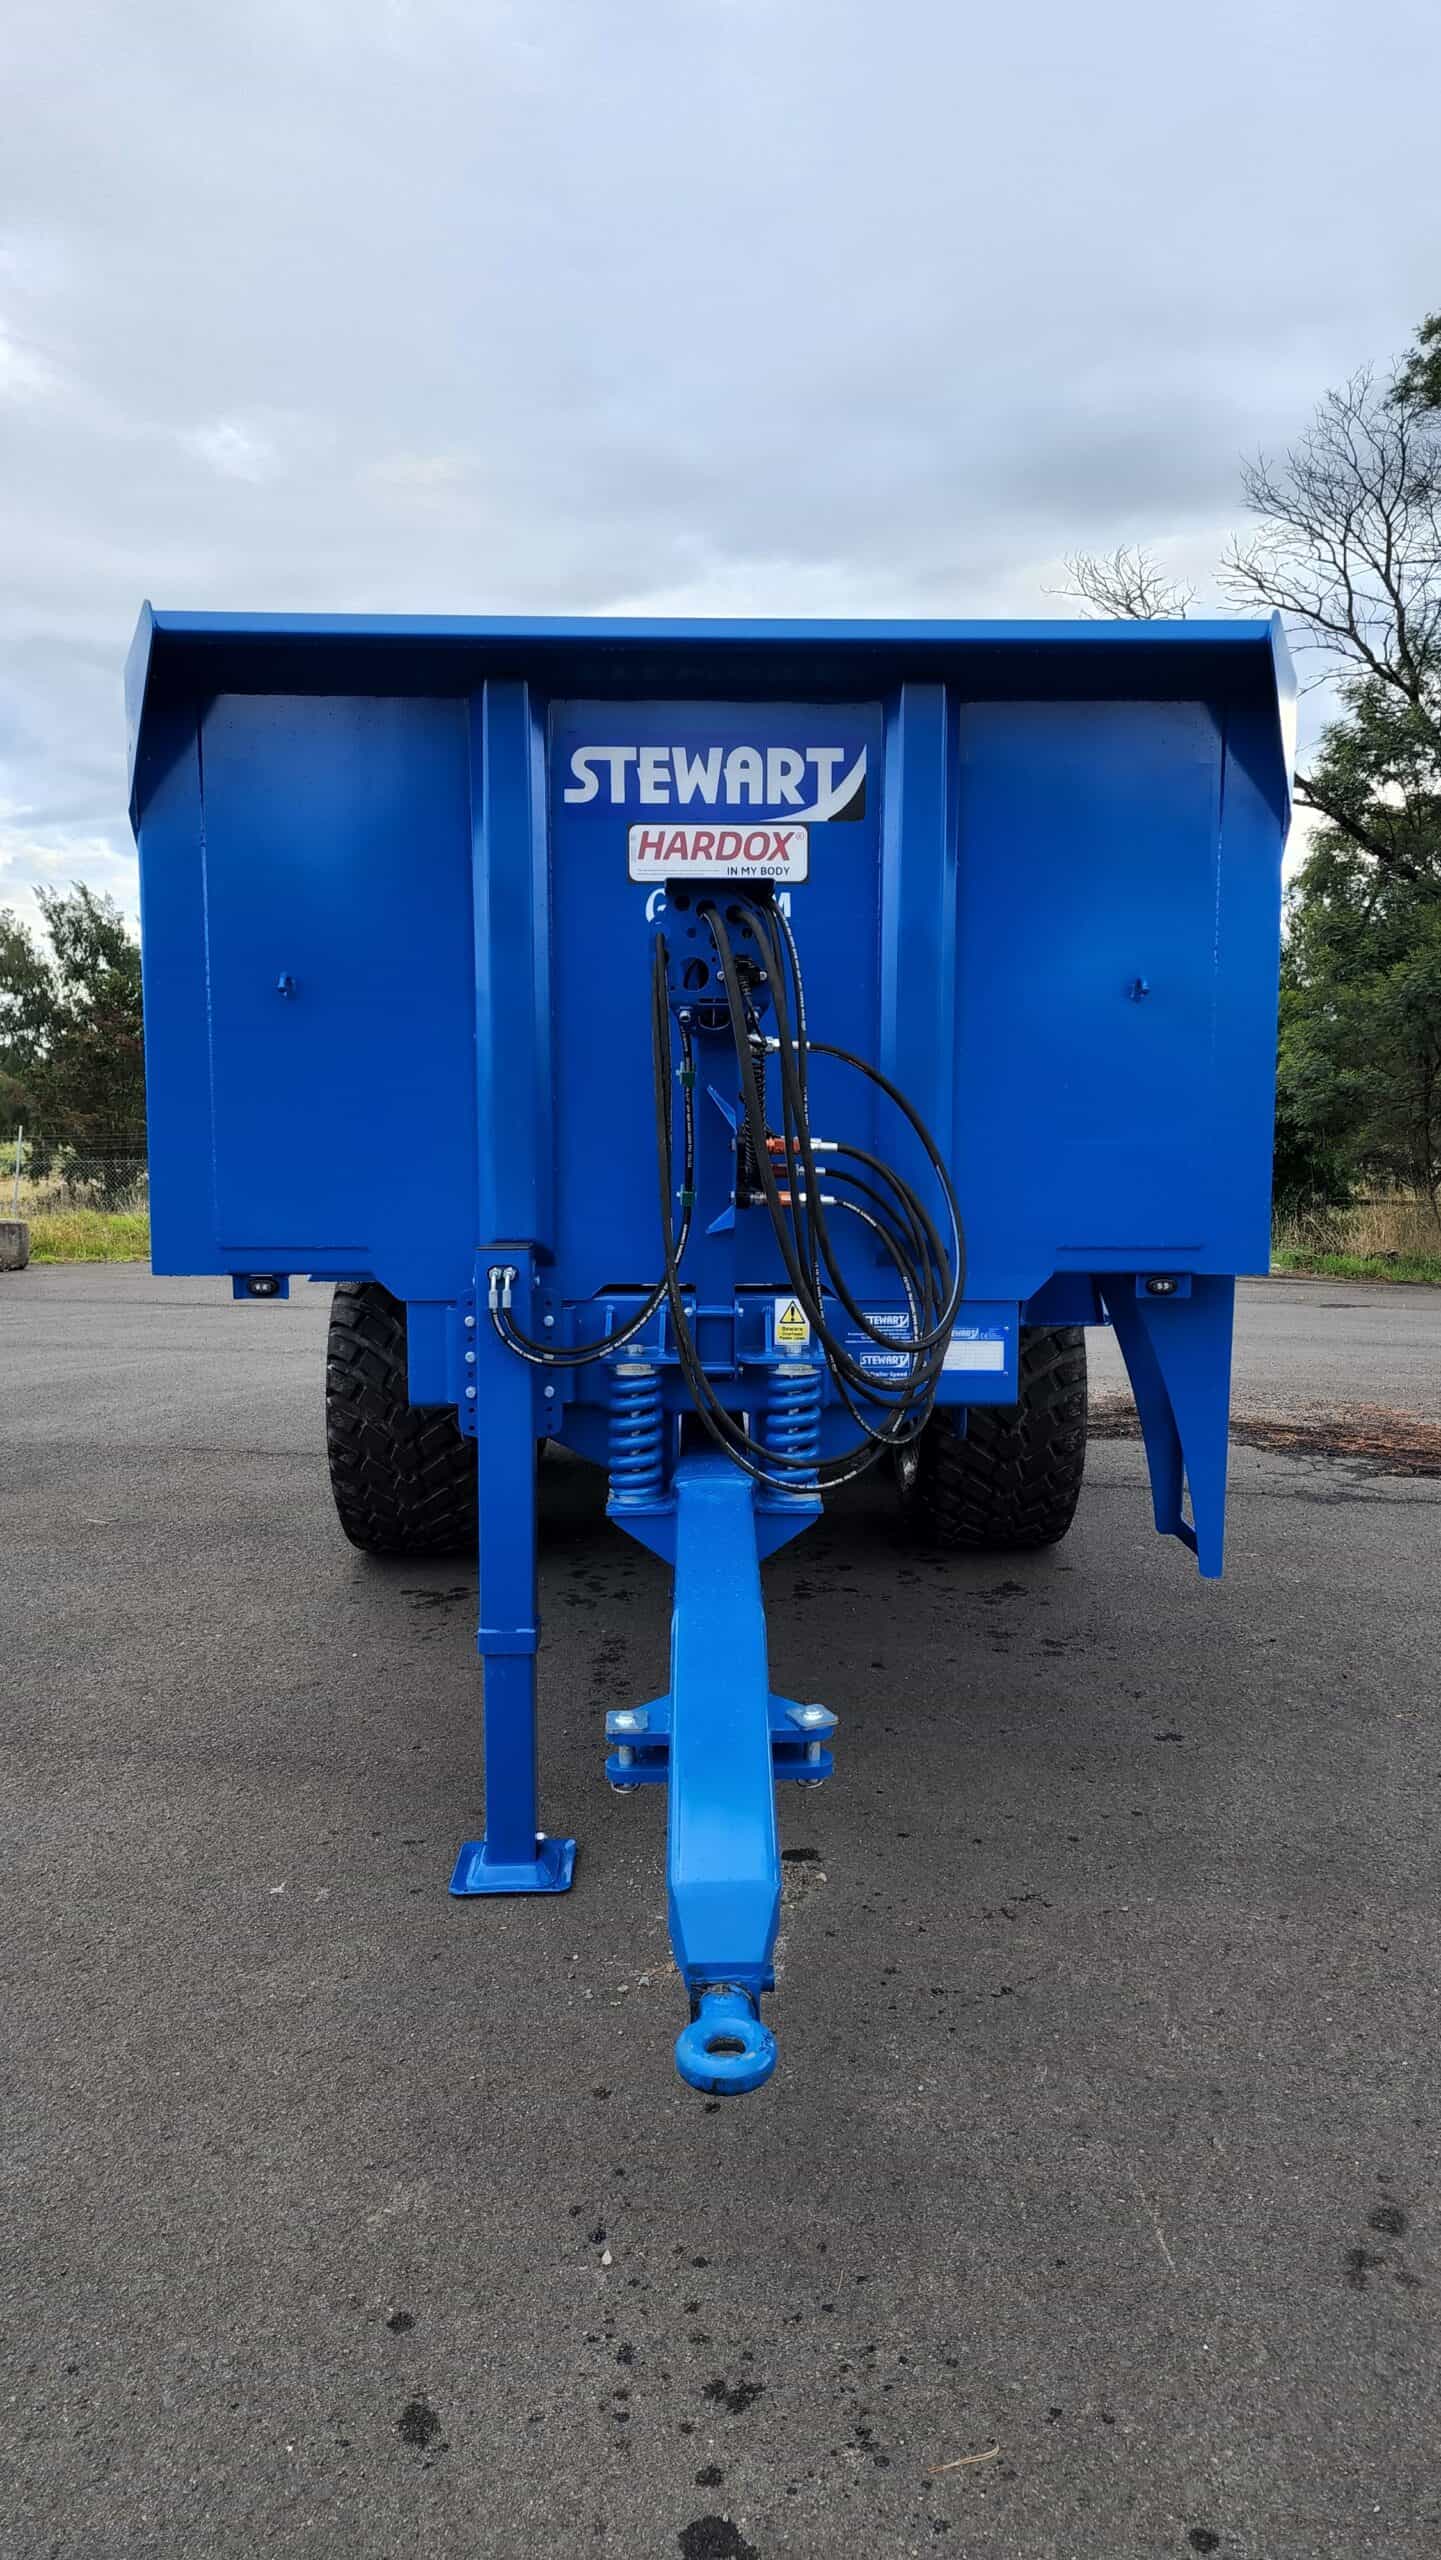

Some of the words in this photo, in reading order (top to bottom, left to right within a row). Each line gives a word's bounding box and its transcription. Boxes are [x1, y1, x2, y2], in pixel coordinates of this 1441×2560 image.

[564, 745, 864, 820] STEWART
[637, 831, 795, 861] HARDOX
[727, 867, 738, 876] IN
[741, 867, 757, 876] MY
[761, 867, 790, 876] BODY
[865, 1315, 909, 1328] TEWART
[860, 1355, 909, 1367] STEWART
